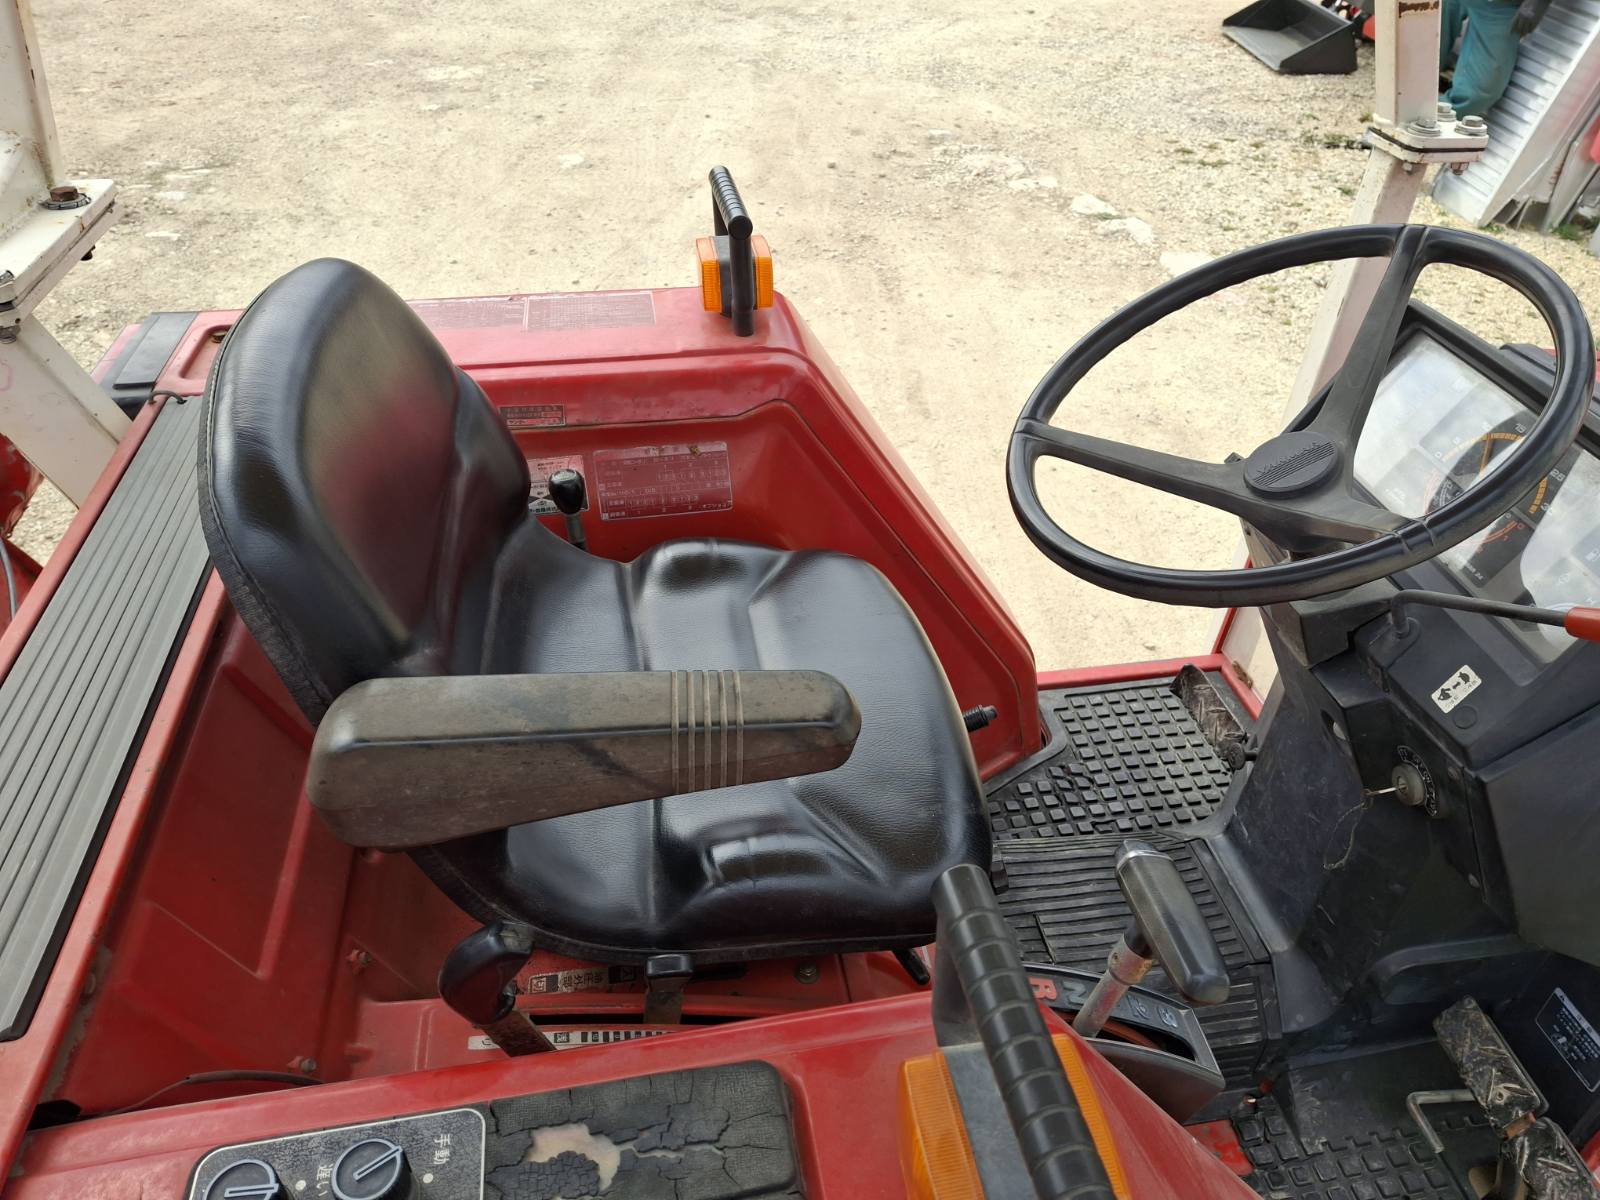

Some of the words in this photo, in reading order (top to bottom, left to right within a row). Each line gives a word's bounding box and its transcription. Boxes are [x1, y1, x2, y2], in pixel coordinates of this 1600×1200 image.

[1515, 424, 1526, 433] 15
[1551, 469, 1563, 481] 25
[1029, 978, 1057, 1001] R
[1063, 982, 1087, 1005] N
[433, 1134, 451, 1165] 手動
[316, 1163, 333, 1197] 遅い
